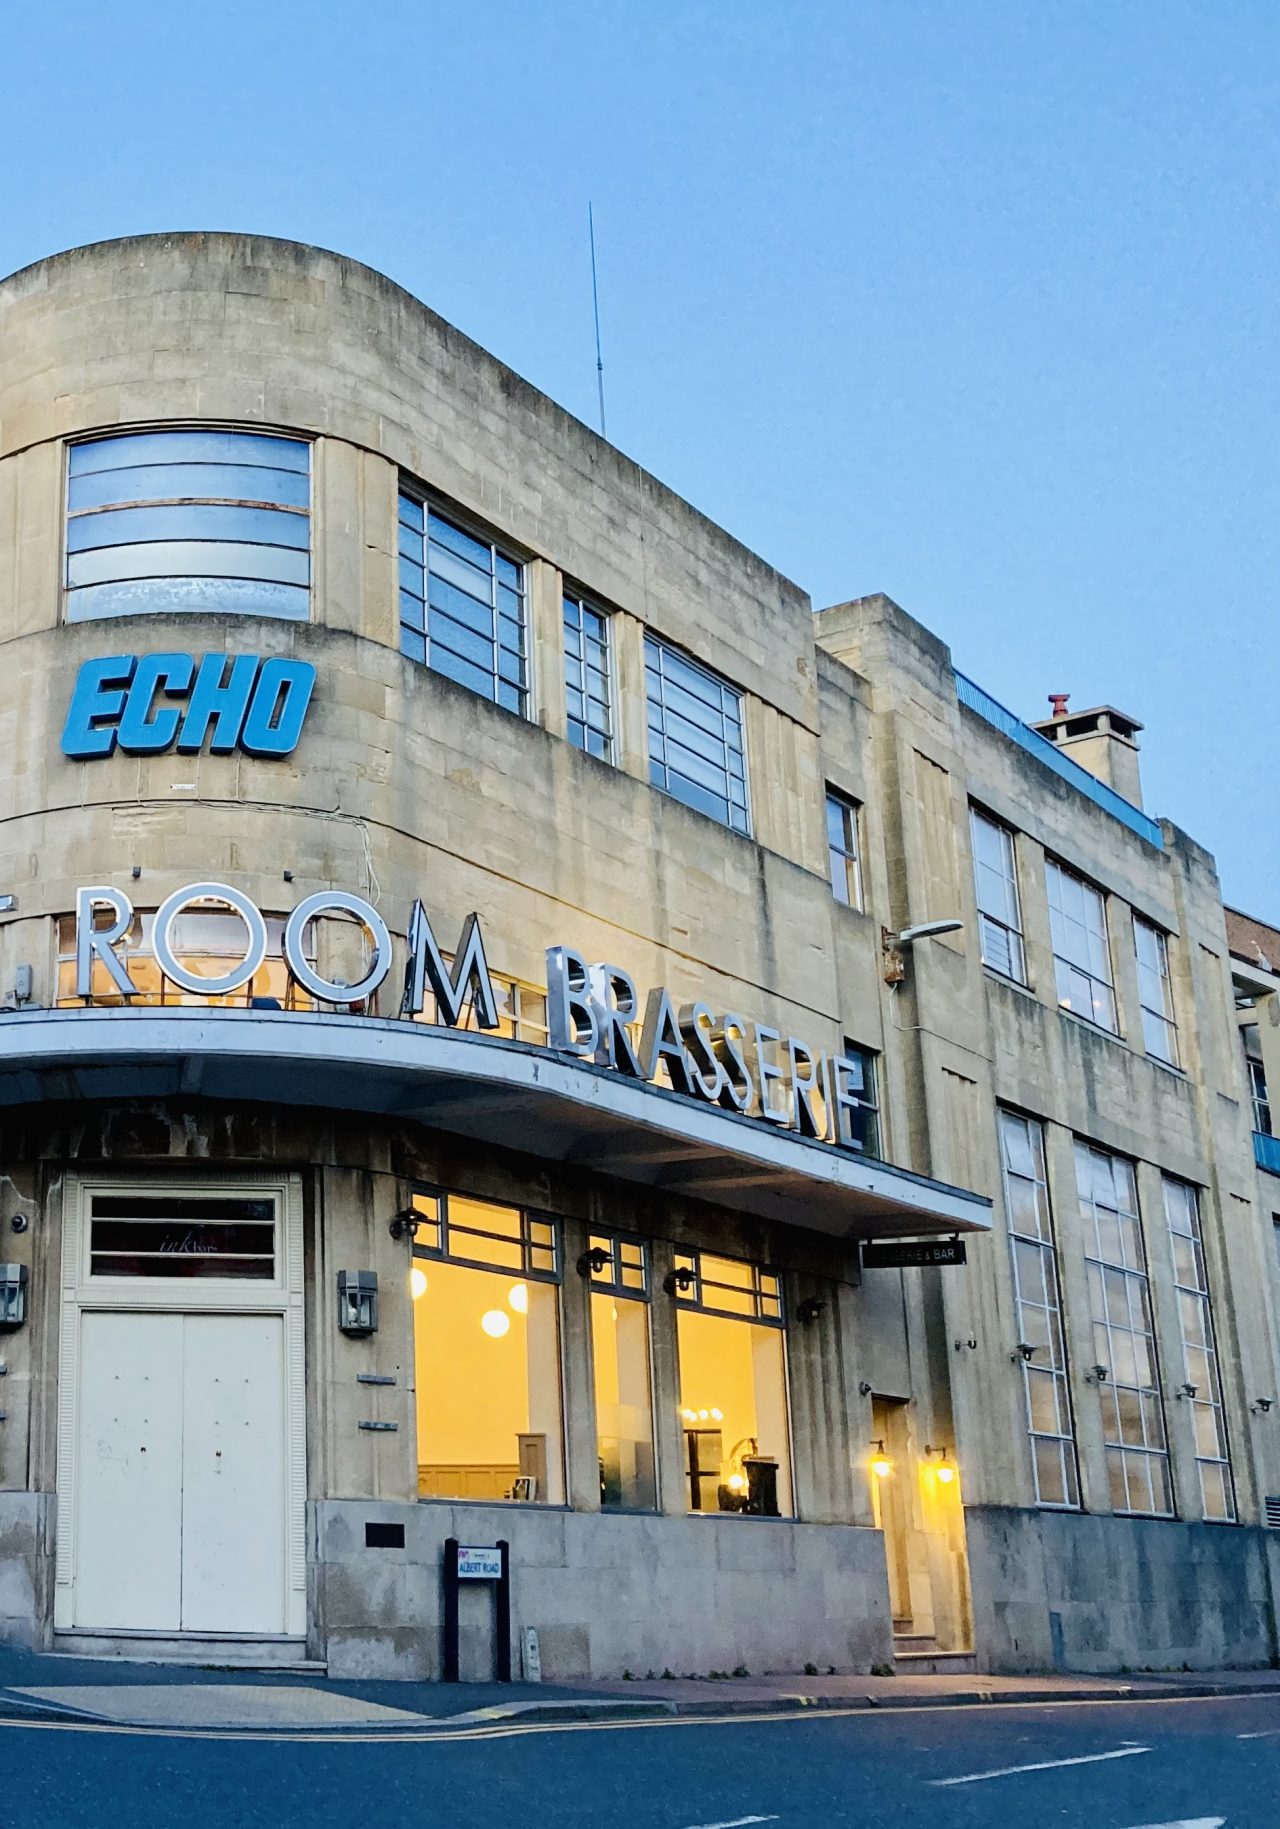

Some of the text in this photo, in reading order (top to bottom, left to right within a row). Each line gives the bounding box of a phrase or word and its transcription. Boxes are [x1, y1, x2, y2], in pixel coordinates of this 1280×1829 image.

[60, 652, 318, 759] ECHO
[75, 881, 500, 1029] ROOM
[545, 944, 864, 1151] BRASSERIE
[933, 1248, 955, 1259] BAR
[459, 1562, 499, 1574] ALBERT ROAD
